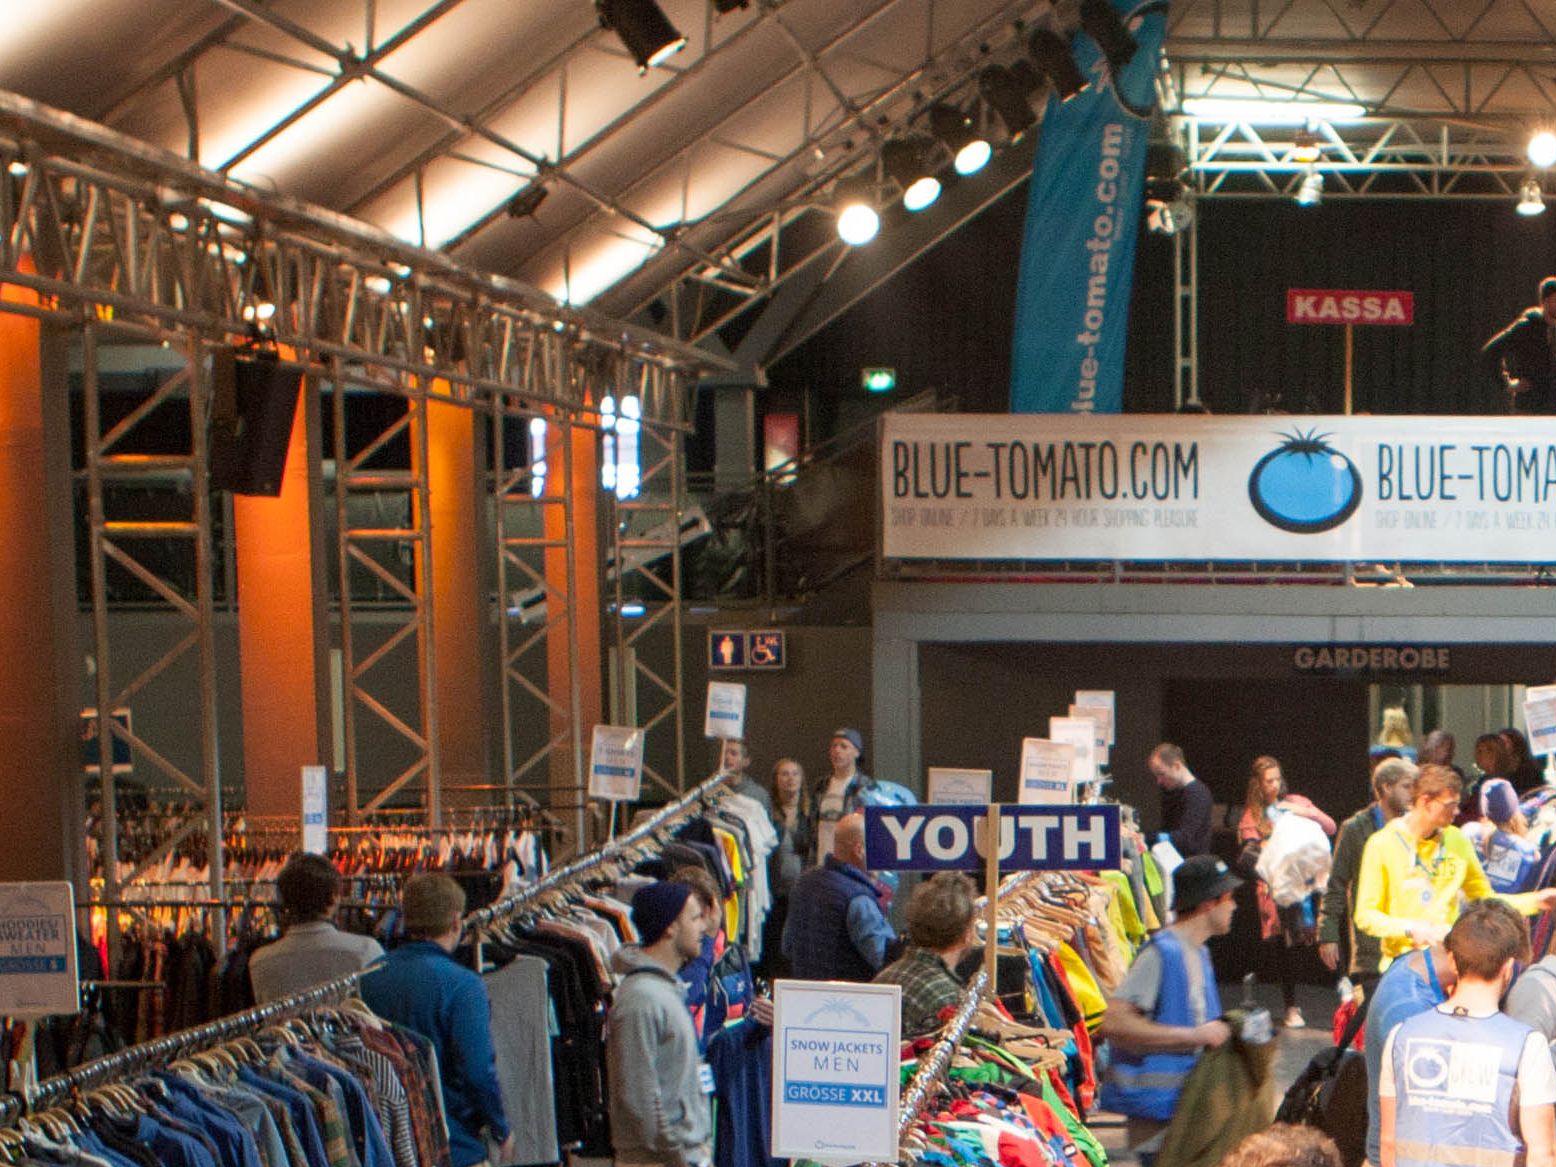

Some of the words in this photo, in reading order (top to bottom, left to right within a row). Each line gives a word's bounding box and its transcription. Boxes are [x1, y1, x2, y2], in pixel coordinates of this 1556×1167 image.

[1072, 122, 1125, 414] lue-tomato.com
[1294, 296, 1405, 320] KASSA
[893, 440, 1199, 499] BLUE-TOMATO.COM
[1294, 648, 1450, 668] GARDEROBE
[881, 815, 1106, 861] YOUTH
[791, 1039, 830, 1052] SNOW
[833, 1042, 883, 1055] JACKETS
[813, 1056, 860, 1073] MEN
[788, 1084, 847, 1102] GRÖSSE
[851, 1088, 882, 1103] XXL
